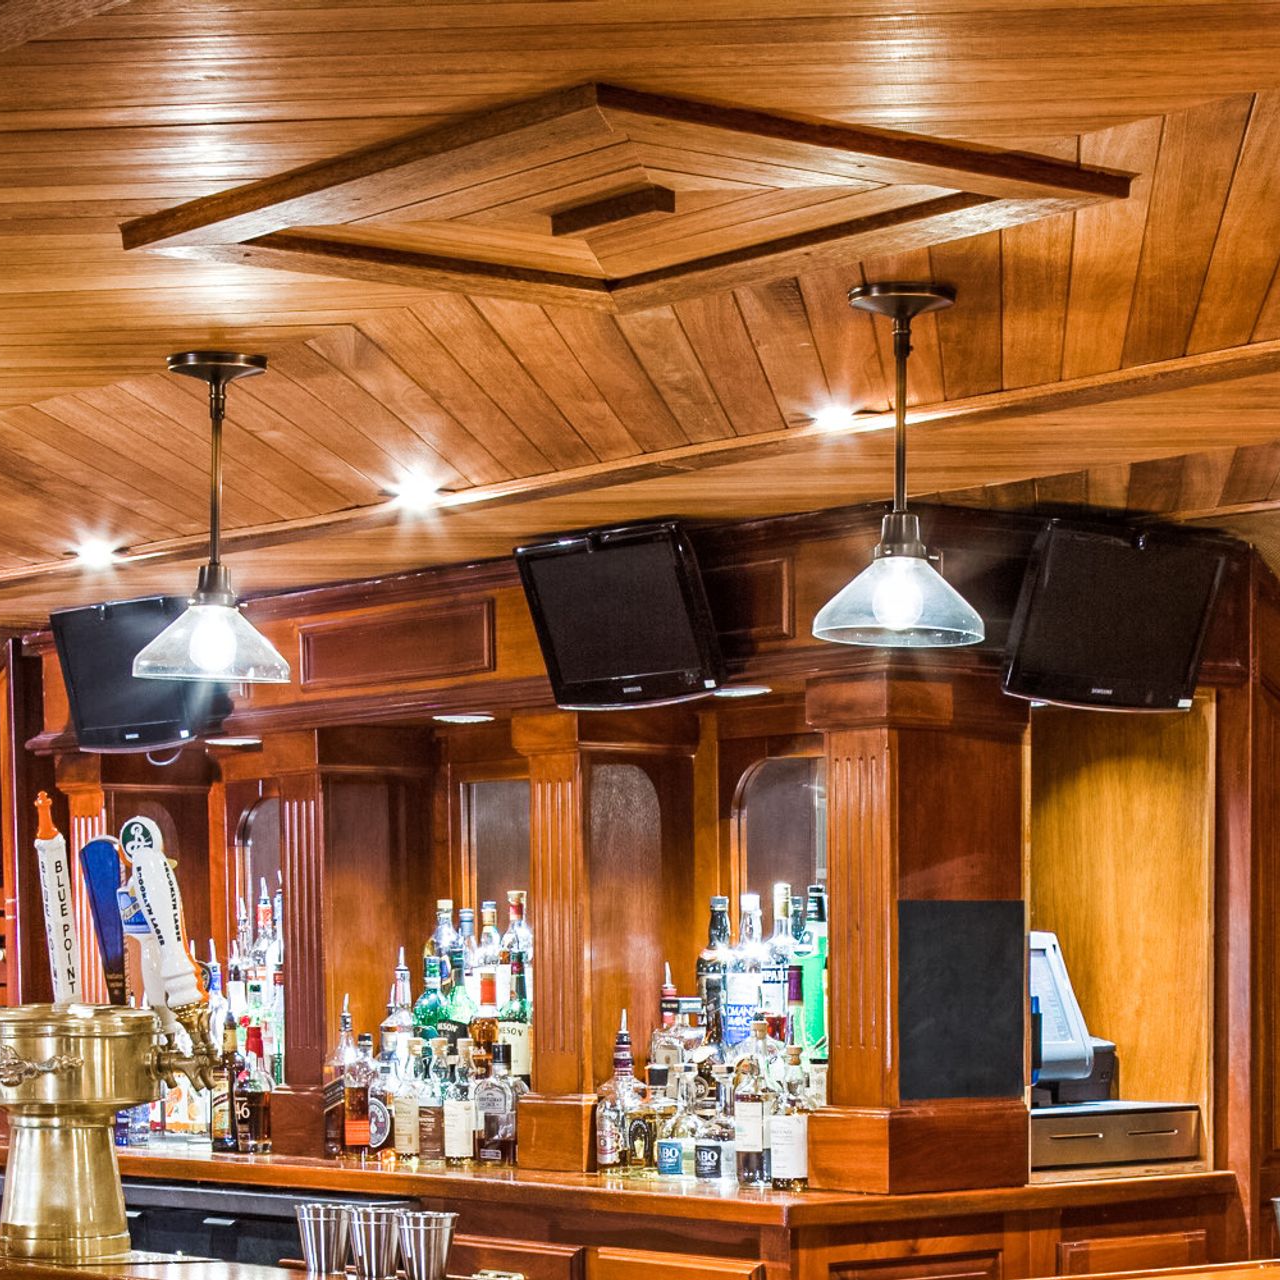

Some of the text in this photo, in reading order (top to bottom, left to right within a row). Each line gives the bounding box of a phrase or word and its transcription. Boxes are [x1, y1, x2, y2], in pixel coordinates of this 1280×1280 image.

[54, 860, 76, 994] BLUE POINT
[150, 917, 165, 946] LAGER
